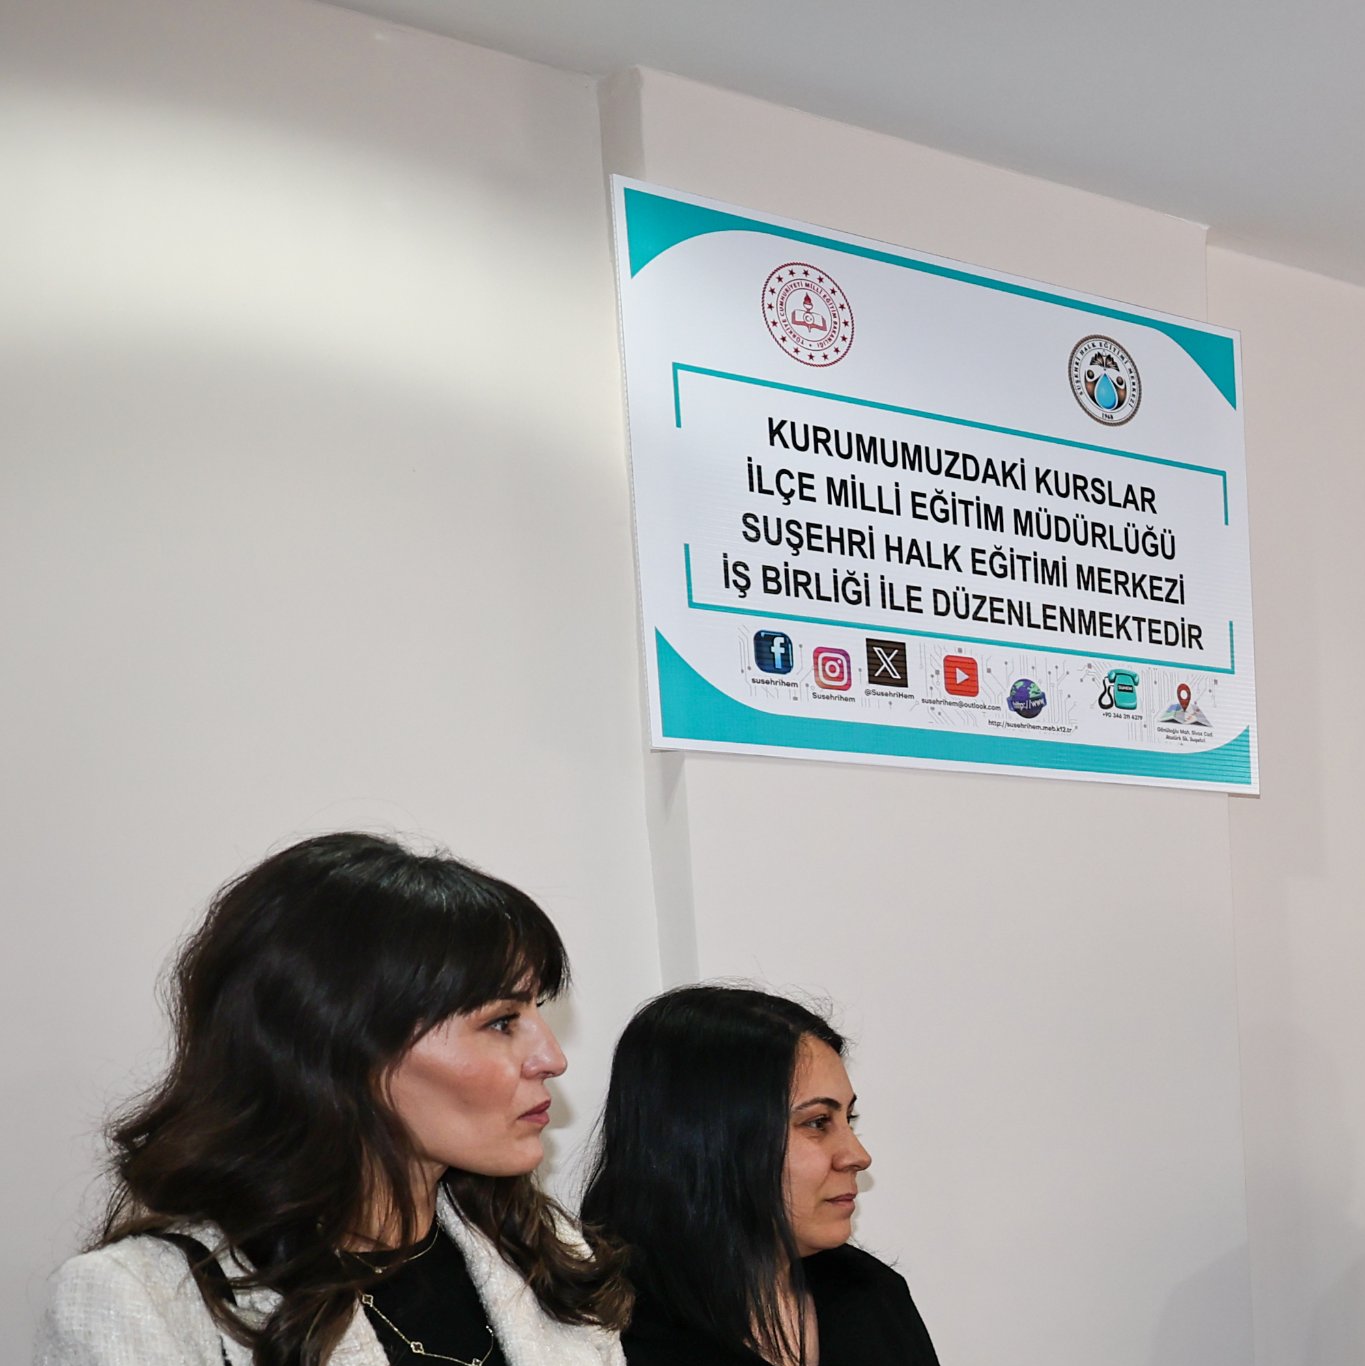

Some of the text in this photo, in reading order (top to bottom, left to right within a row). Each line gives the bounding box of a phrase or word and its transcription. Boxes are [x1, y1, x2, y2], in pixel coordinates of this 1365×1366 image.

[747, 456, 1176, 560] İLÇE MİLLİ EĞİTİM MÜDÜRLÜĞÜ
[768, 417, 1158, 514] KURUMUMUZDAKİ KURSLAR
[722, 552, 1204, 650] İŞ BİRLİĞİ İLE DÜZENLENMEKTEDİR
[742, 512, 1185, 605] SUŞEHRİ HALK EĞİTİMİ MERKEZİ
[751, 677, 799, 688] susehrihem
[812, 692, 856, 703] Susehrihem
[921, 698, 1002, 711] susehrihem@outlook.com
